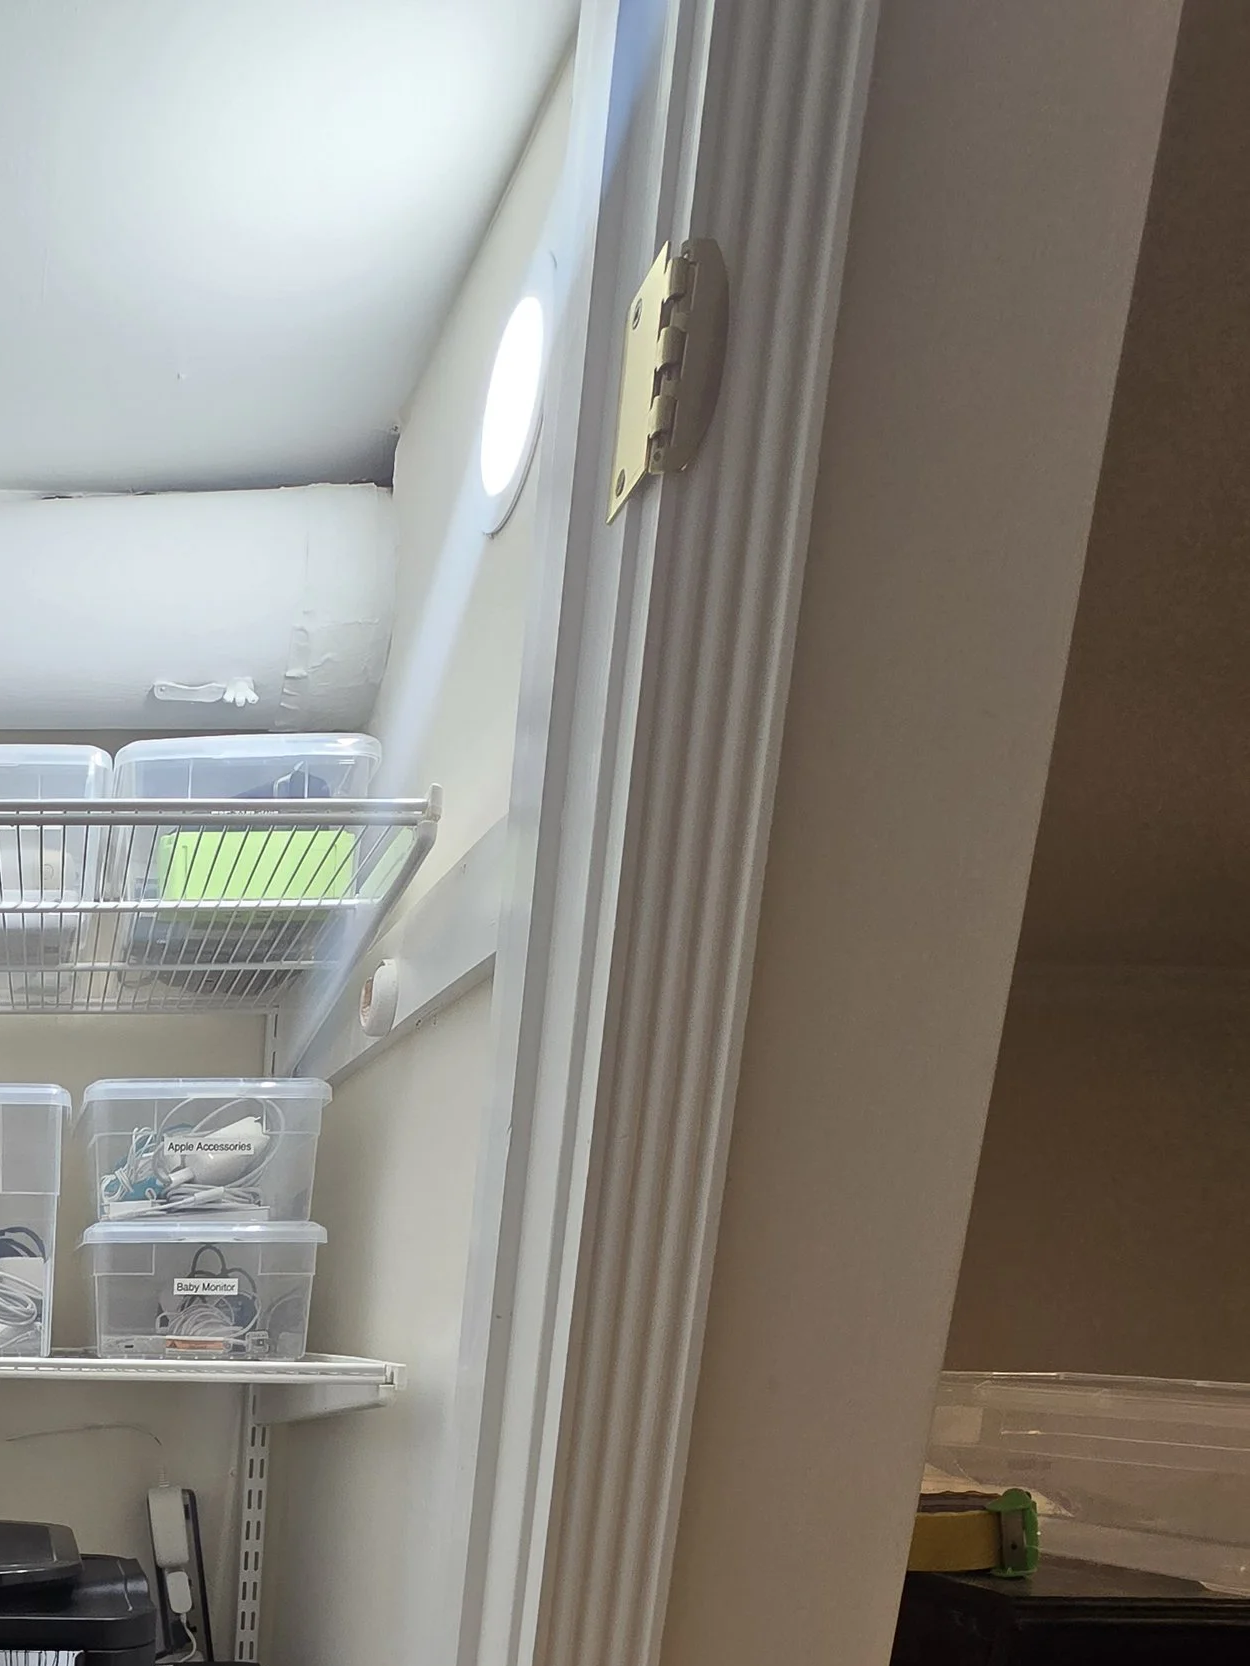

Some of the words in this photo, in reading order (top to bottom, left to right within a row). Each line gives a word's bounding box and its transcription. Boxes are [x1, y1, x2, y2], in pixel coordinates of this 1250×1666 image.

[167, 1141, 194, 1153] Apple
[196, 1141, 252, 1152] Accessories
[176, 1282, 200, 1293] Baby
[201, 1282, 236, 1292] Monitor
